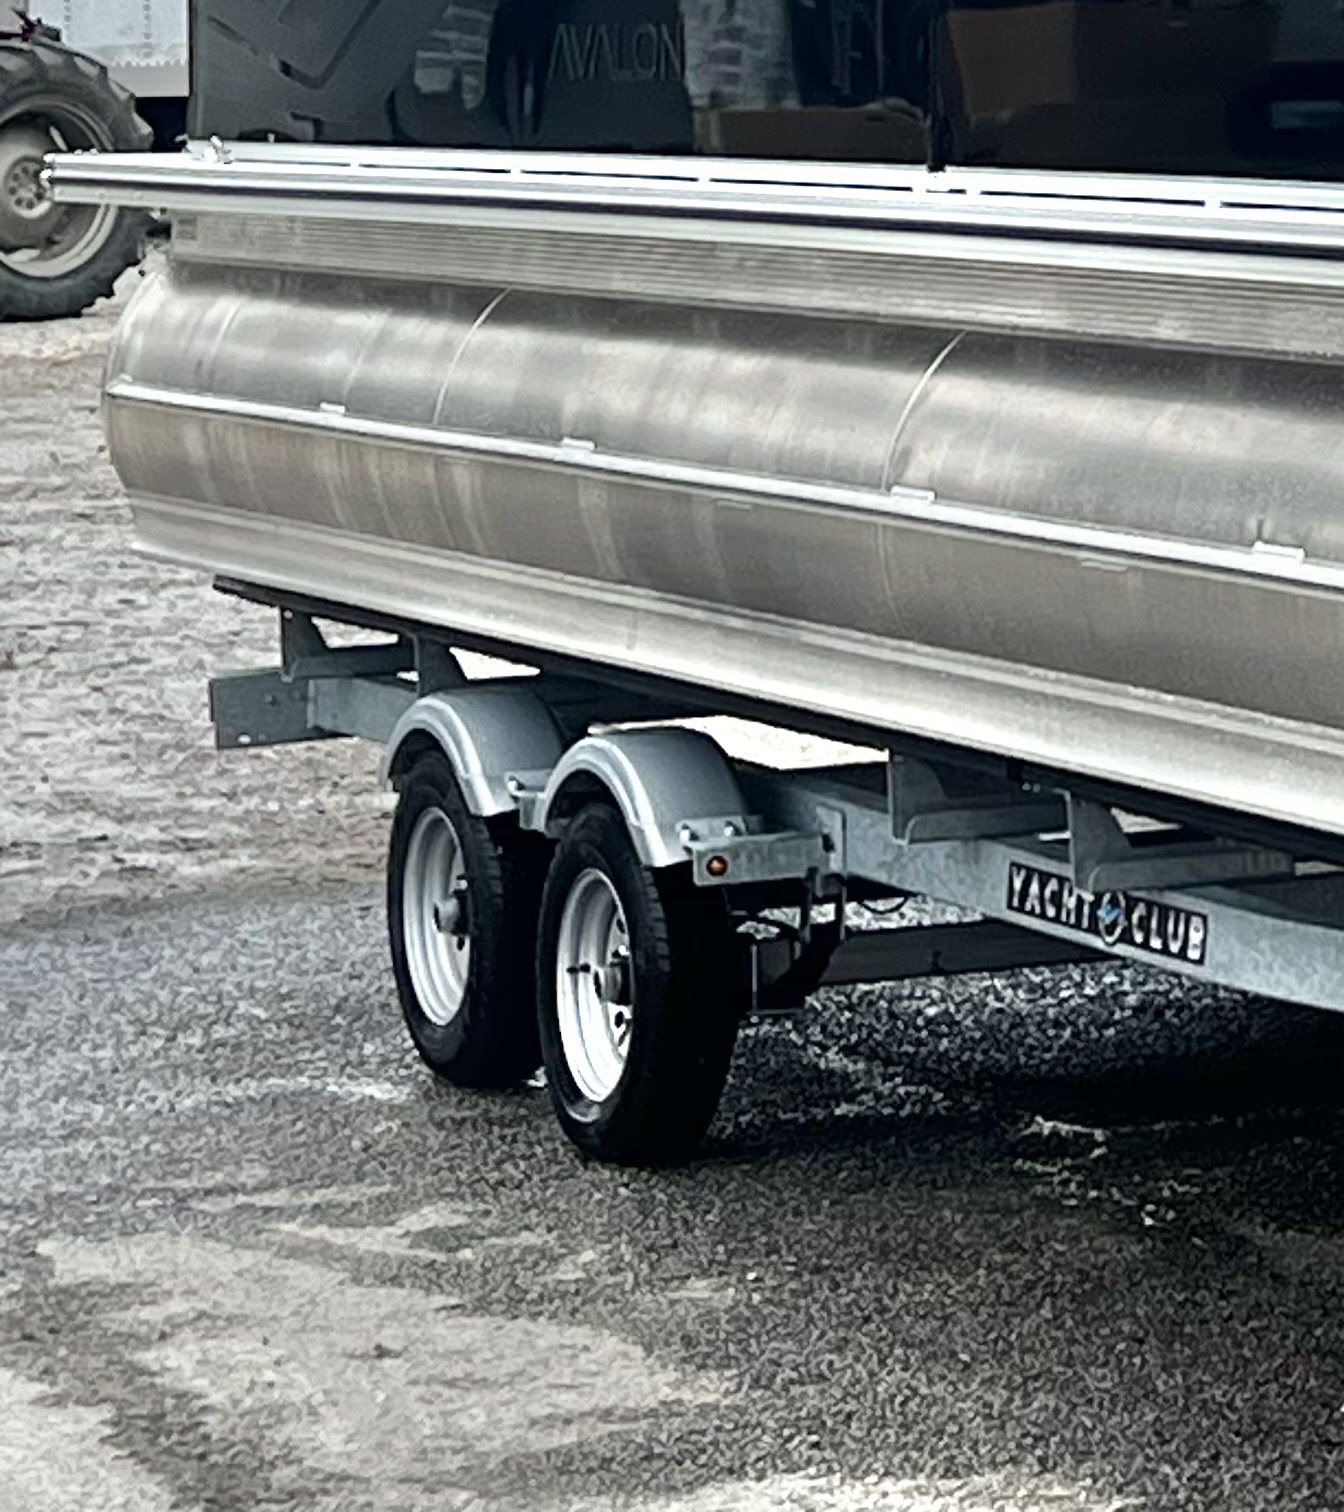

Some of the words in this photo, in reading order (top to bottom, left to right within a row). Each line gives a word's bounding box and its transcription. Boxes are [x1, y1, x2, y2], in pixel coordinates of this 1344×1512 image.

[548, 23, 682, 81] AVALON
[1010, 865, 1096, 929] YACHT
[1131, 901, 1205, 961] CLUB
